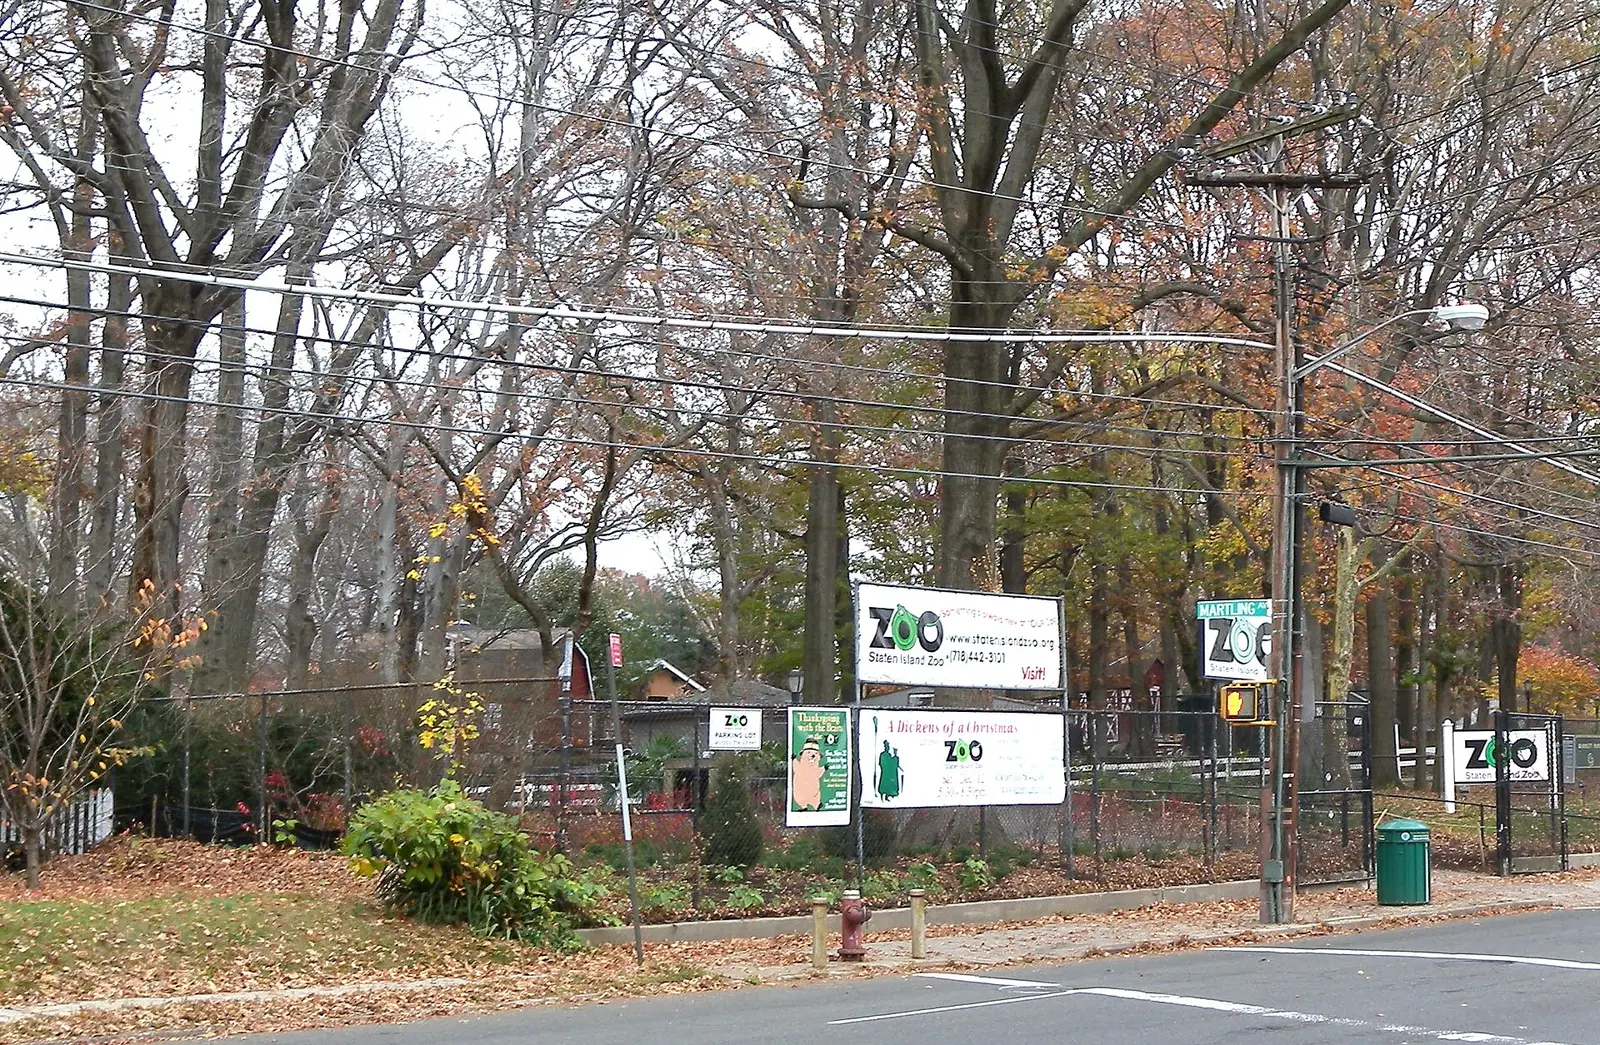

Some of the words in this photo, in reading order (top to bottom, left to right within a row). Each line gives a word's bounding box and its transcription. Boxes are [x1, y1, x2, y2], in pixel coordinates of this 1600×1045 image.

[1199, 602, 1255, 616] MARTLING
[869, 604, 944, 652] ZOO
[869, 651, 898, 664] Staten
[900, 653, 925, 665] Island
[927, 655, 944, 667] Zoo
[1022, 666, 1046, 680] Visit!
[1210, 663, 1234, 672] Staten
[1237, 665, 1259, 675] Island
[725, 713, 748, 727] ZOO
[798, 712, 840, 725] Thanksgiving
[797, 723, 814, 732] with
[815, 722, 826, 732] the
[887, 720, 894, 733] A
[897, 719, 940, 733] Dickens
[943, 719, 956, 737] of
[957, 723, 964, 734] a
[967, 719, 1018, 734] Christmas
[944, 738, 983, 762] ZOO
[1465, 771, 1492, 780] Staten
[1522, 770, 1538, 779] Zoo
